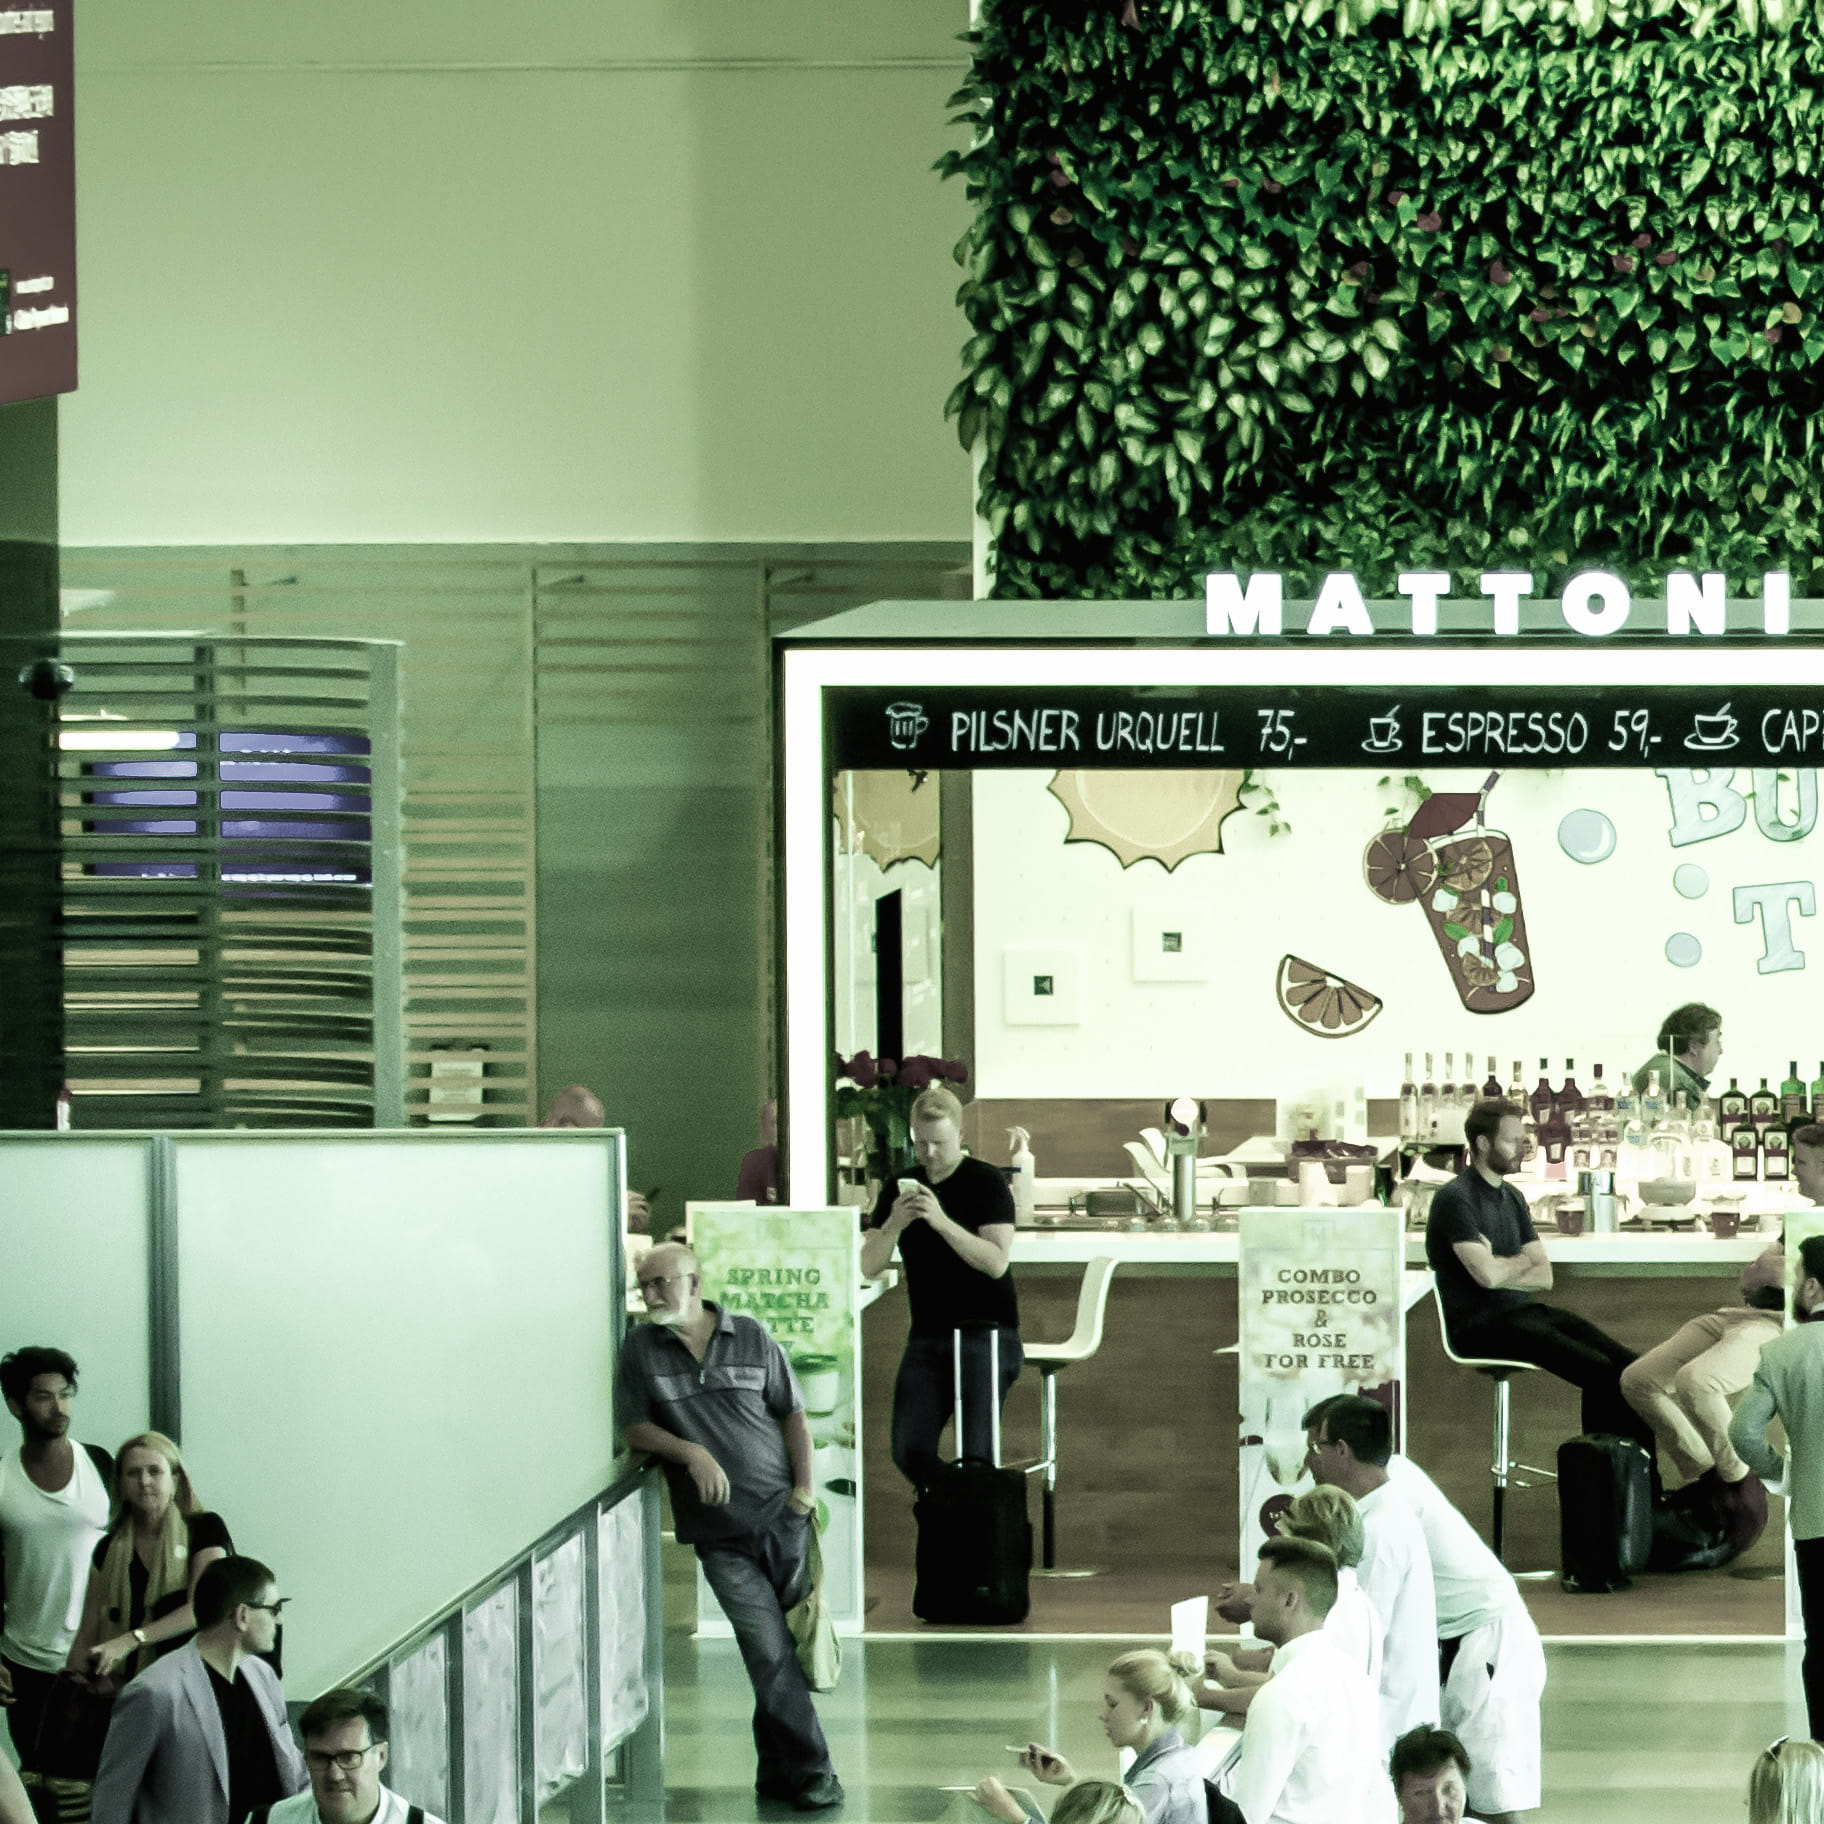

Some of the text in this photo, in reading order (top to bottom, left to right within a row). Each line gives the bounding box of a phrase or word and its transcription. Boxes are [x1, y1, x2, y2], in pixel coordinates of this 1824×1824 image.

[1206, 571, 1790, 636] MATTONI
[952, 709, 1308, 761] PILSNER URQUELL 75,-
[1422, 709, 1661, 758] ESPRESSO 59,-
[727, 1268, 820, 1285] SPRING
[1278, 1269, 1361, 1284] COMBO
[720, 1291, 829, 1309] MATCHA
[1262, 1290, 1377, 1304] PROSECCO
[1314, 1309, 1329, 1328] &
[1293, 1333, 1346, 1348] ROSE
[1265, 1354, 1374, 1369] FOR FREE
